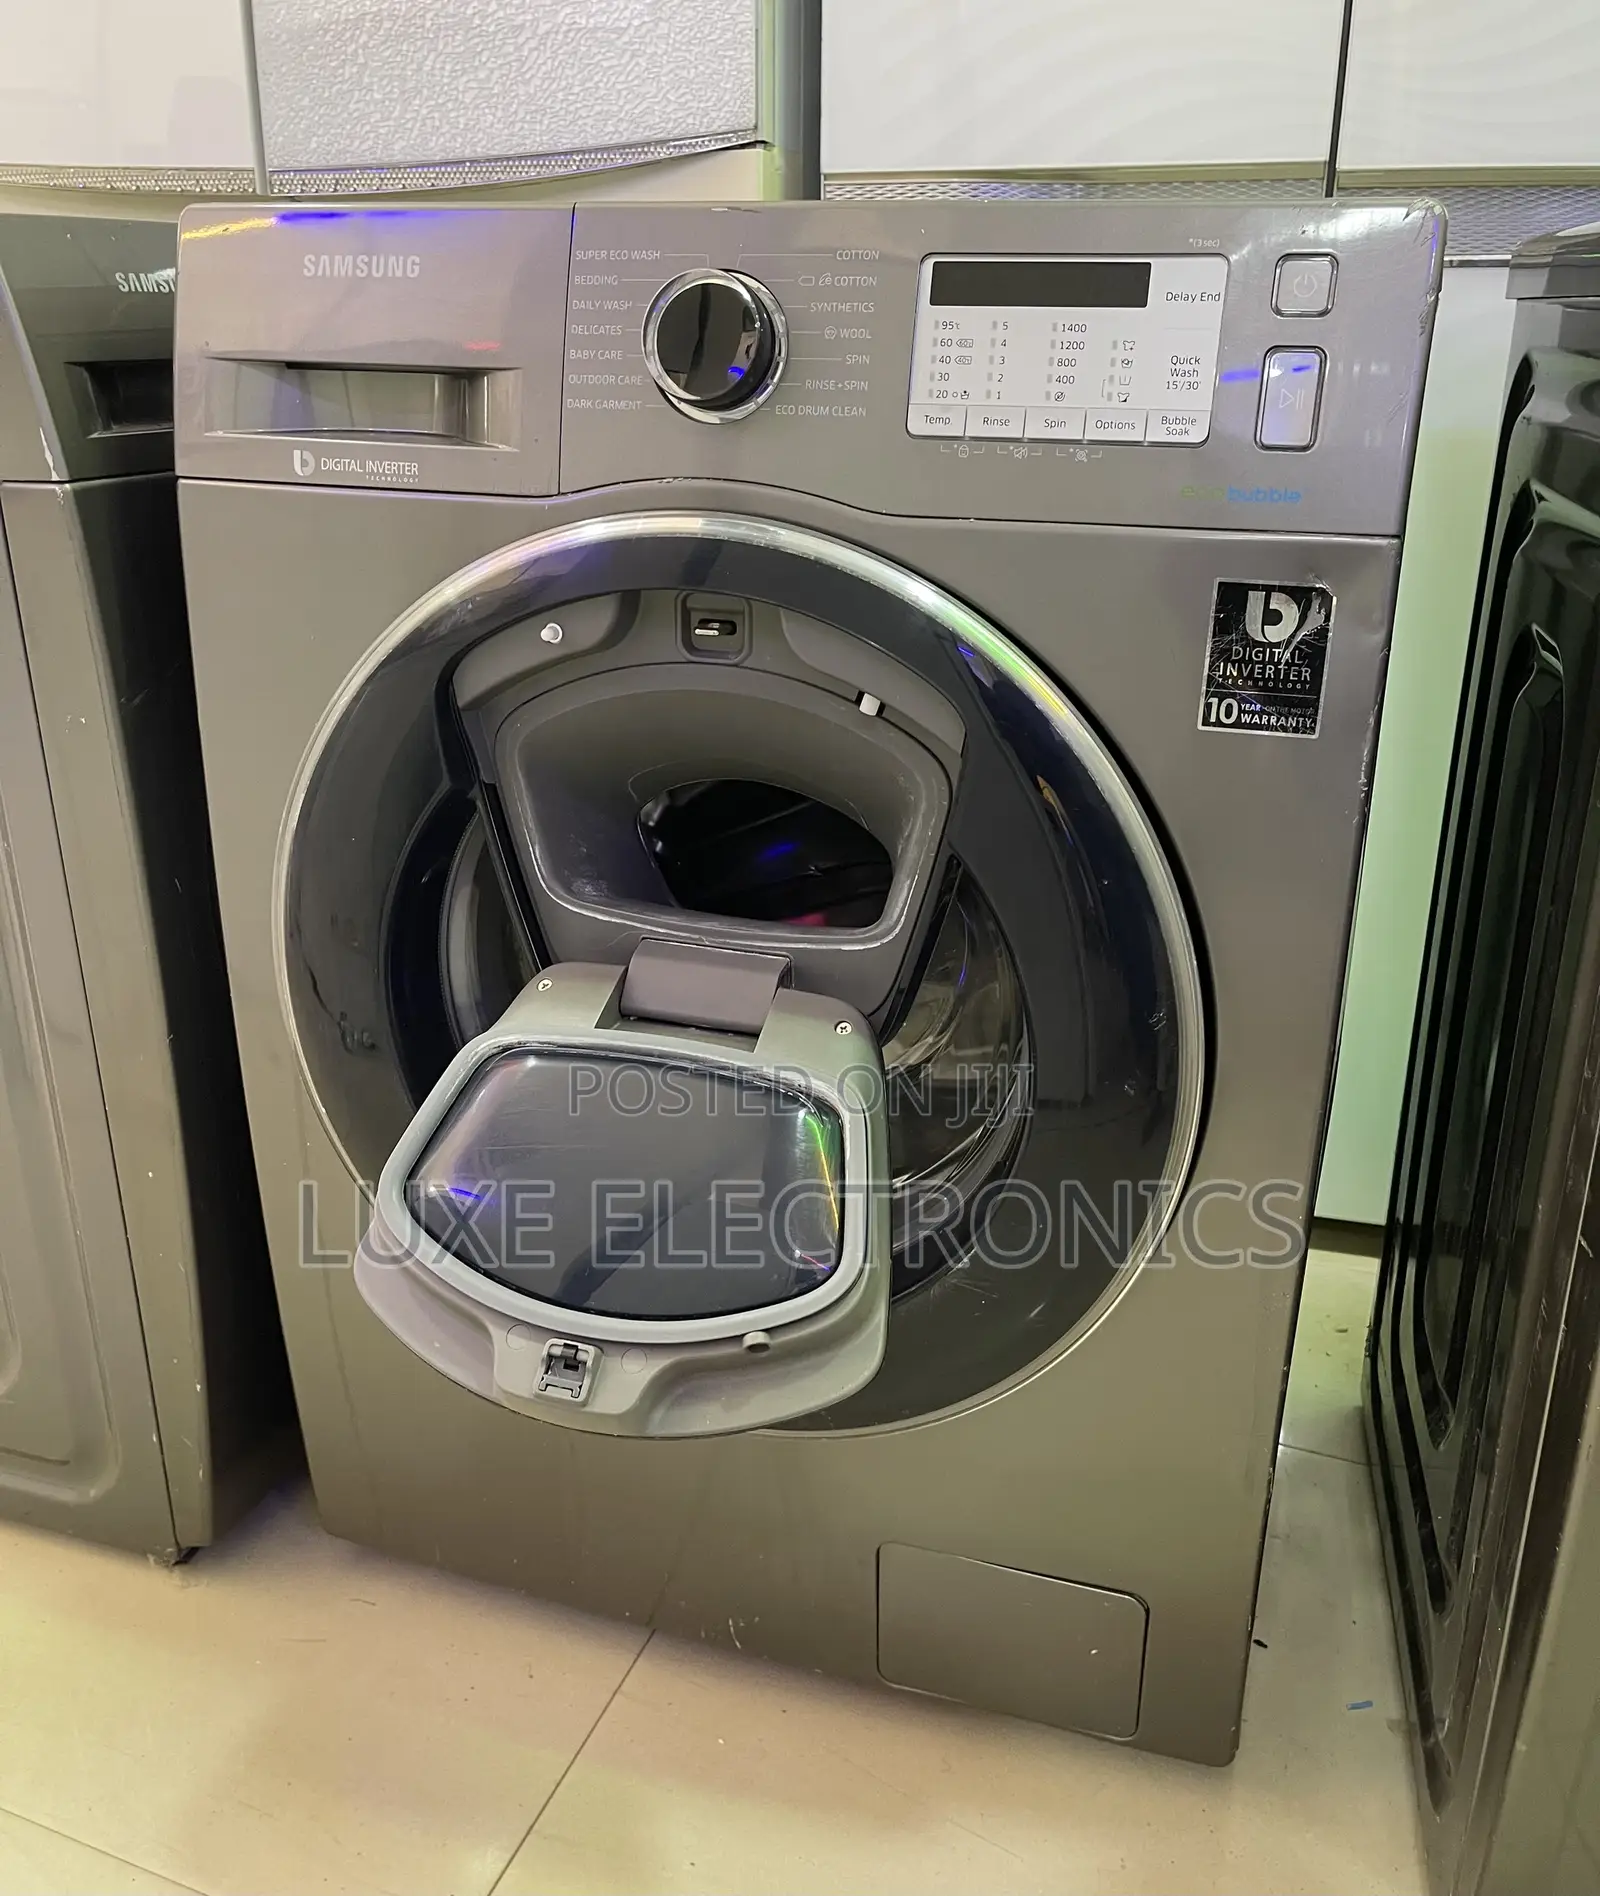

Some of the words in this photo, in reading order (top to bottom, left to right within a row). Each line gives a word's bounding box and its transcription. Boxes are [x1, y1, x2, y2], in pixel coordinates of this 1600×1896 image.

[575, 249, 607, 261] SUPER
[609, 249, 629, 261] ECO
[630, 249, 661, 261] WASH
[836, 249, 880, 261] COTTON
[303, 254, 421, 279] SAMSUNG
[574, 274, 619, 286] BEDDING
[834, 275, 878, 287] COTTON
[1165, 291, 1198, 304] Delay
[1199, 291, 1221, 303] End
[572, 300, 602, 310] DAILY
[603, 300, 633, 311] WASH
[810, 302, 875, 313] SYNTHETICS
[571, 324, 623, 336] DELICATES
[1002, 321, 1009, 331] 5
[1061, 323, 1088, 333] 1400
[839, 328, 872, 340] WOOL
[939, 338, 953, 348] 60
[1000, 339, 1008, 348] 4
[1060, 340, 1086, 351] 1200
[569, 349, 596, 360] BABY
[597, 350, 623, 360] CARE
[845, 354, 870, 365] SPIN
[938, 355, 952, 365] 40
[1170, 355, 1201, 366] Quick
[998, 356, 1006, 366] 3
[1056, 357, 1077, 368] 800
[937, 372, 951, 382] 30
[997, 373, 1005, 383] 2
[1170, 368, 1200, 379] Wash
[568, 374, 616, 385] OUTDOOR
[617, 375, 643, 386] CARE
[805, 379, 869, 391] RINSE+SPIN
[1055, 375, 1076, 385] 400
[935, 389, 949, 399] 20
[996, 391, 1002, 400] 1
[566, 398, 593, 409] DARK
[595, 398, 643, 411] GARMENT
[775, 404, 796, 416] ECO
[797, 405, 830, 416] DRUM
[831, 405, 867, 417] CLEAN
[923, 414, 953, 426] Temp.
[982, 416, 1011, 428] Rinse
[1044, 418, 1067, 430] Spin
[1095, 419, 1137, 431] Options
[1160, 415, 1198, 427] Bubble
[1165, 427, 1191, 437] Soak
[320, 457, 364, 473] DIGITAL
[365, 460, 419, 476] INVERTER
[365, 475, 420, 483] TECHNOLOGY
[1231, 645, 1304, 665] DIGITAL
[1218, 661, 1312, 682] INVERTER
[1218, 677, 1312, 690] TECHNOLOGY
[1207, 697, 1239, 725] 10
[1240, 703, 1262, 713] YEAR
[1240, 713, 1313, 729] WARRANTY
